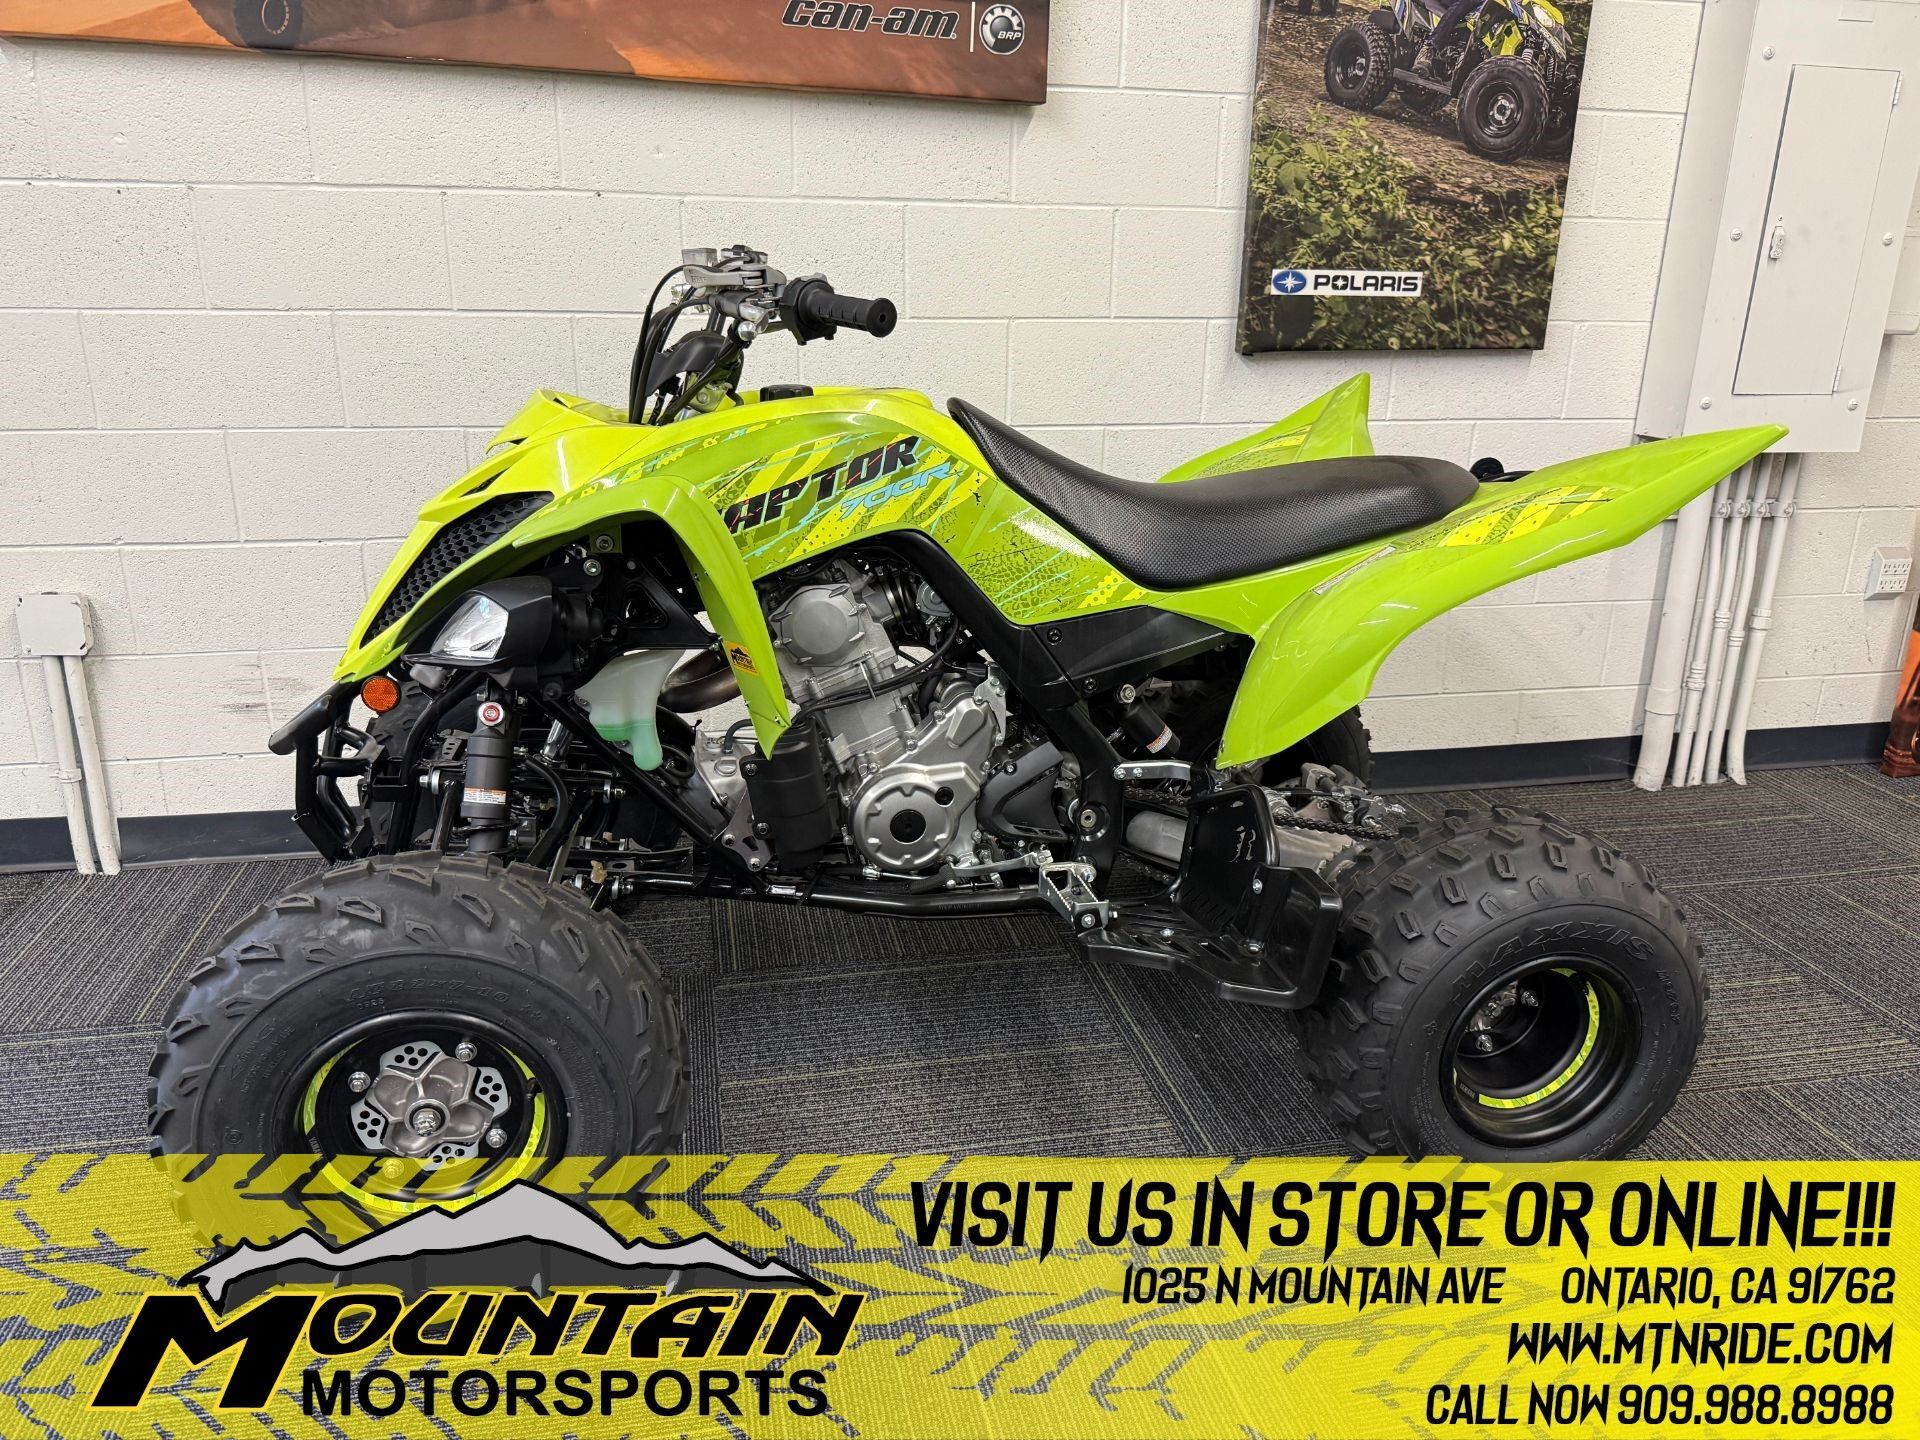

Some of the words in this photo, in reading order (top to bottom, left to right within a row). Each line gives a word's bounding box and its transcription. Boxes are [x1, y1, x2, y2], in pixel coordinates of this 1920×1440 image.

[781, 0, 960, 40] can-am
[997, 30, 1022, 41] BRP
[1313, 274, 1419, 292] POLARIS
[717, 435, 922, 537] APTOR
[837, 461, 951, 522] 700R
[1453, 921, 1654, 1002] MAXXIS
